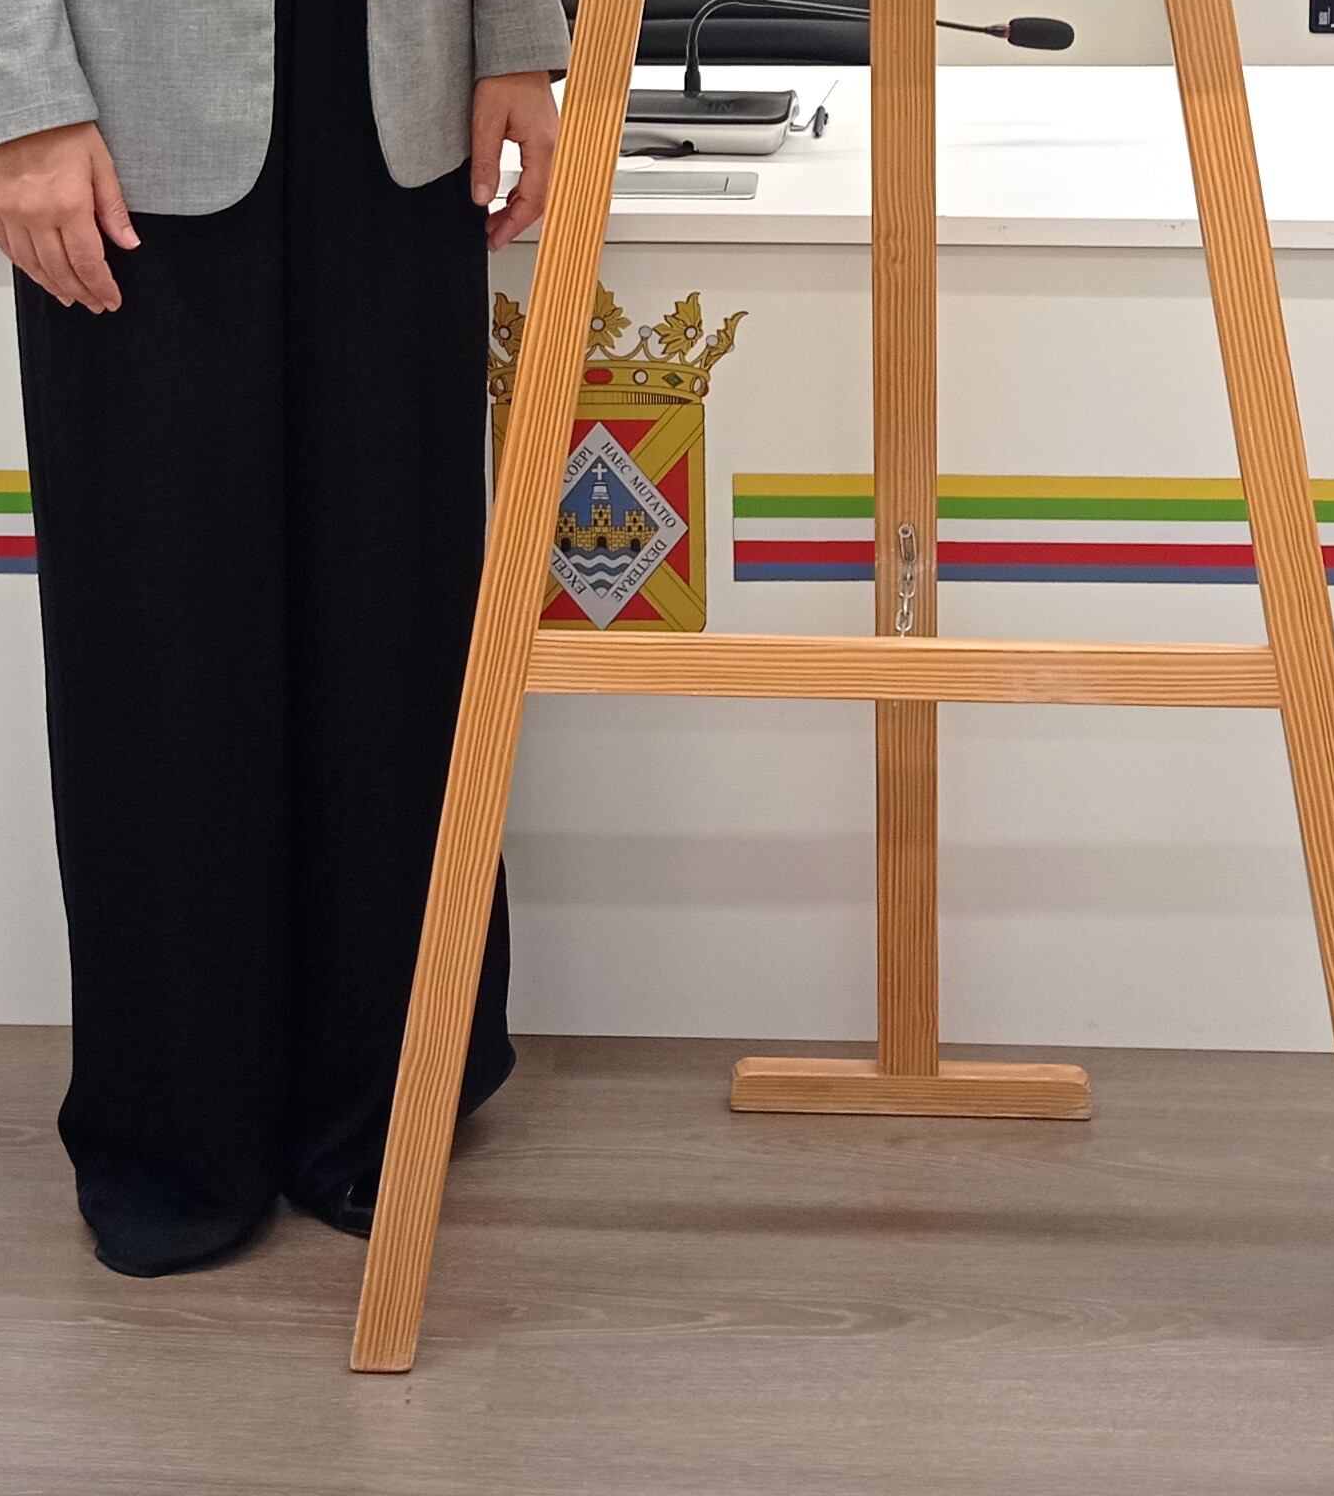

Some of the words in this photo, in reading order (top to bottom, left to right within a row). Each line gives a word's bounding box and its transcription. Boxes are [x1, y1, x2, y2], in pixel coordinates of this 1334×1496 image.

[600, 442, 632, 475] HAEC
[630, 475, 676, 530] MUTATIO
[551, 553, 587, 596] EXCEL
[611, 538, 668, 603] DEXTERAE
